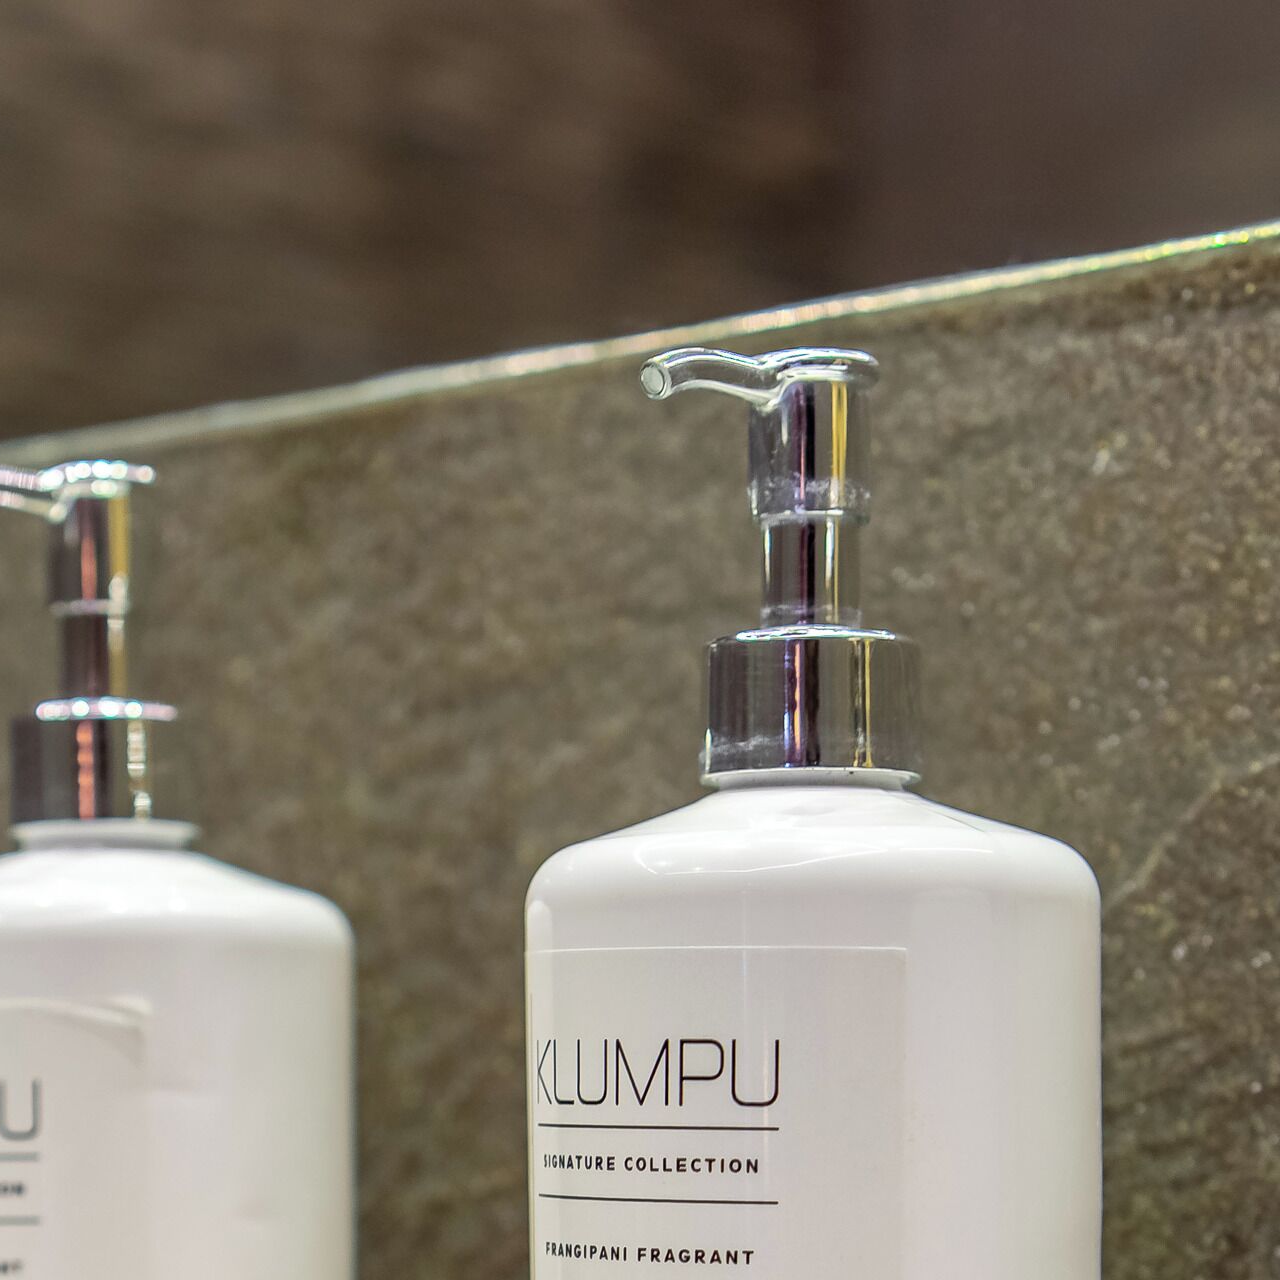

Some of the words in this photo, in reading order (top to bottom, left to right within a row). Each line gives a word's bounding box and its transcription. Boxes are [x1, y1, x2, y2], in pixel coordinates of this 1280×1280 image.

[537, 1038, 779, 1107] KLUMPU
[543, 1154, 616, 1171] SIGNATURE
[624, 1157, 759, 1173] COLLECTION
[545, 1242, 628, 1261] FRANGIPANI
[637, 1248, 755, 1264] FRAGRANT
